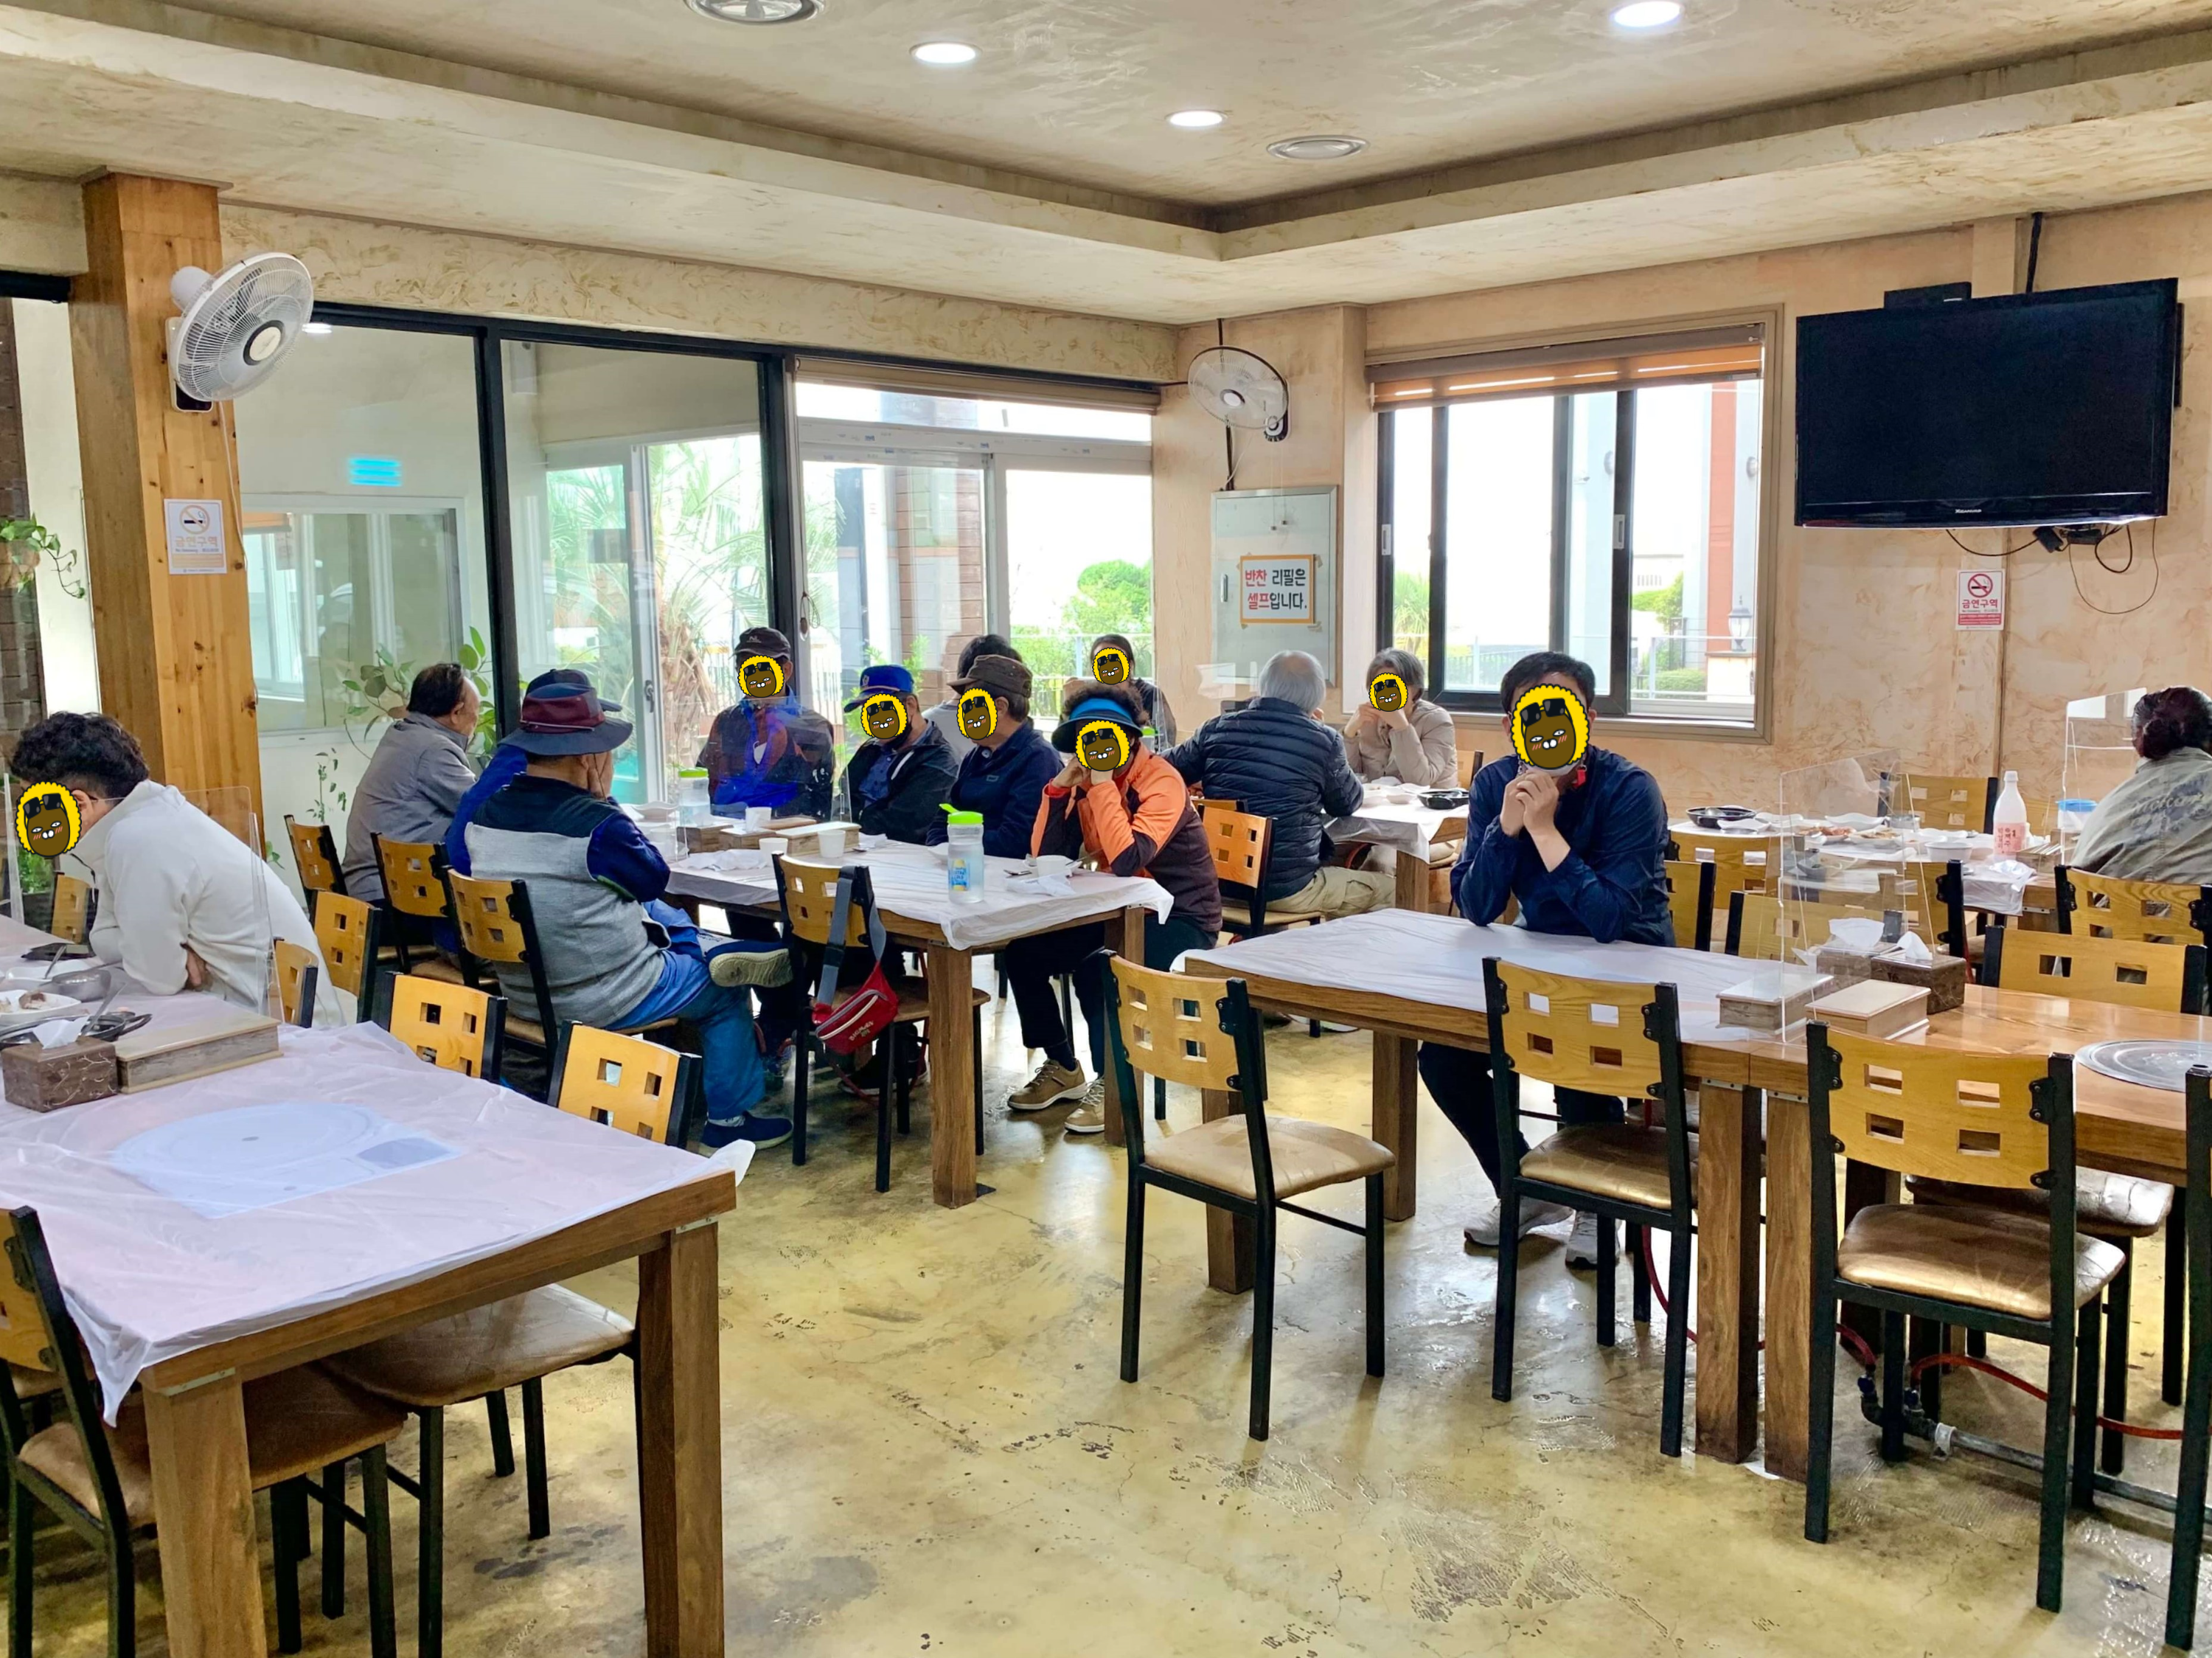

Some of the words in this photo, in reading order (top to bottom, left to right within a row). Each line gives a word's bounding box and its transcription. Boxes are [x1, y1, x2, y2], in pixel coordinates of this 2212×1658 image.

[175, 535, 218, 547] 금연구역
[1245, 569, 1267, 587] 반찬
[1272, 569, 1306, 586] 리필은
[1248, 592, 1307, 610] 셀프입니다.
[1962, 598, 1998, 608] 금연구역
